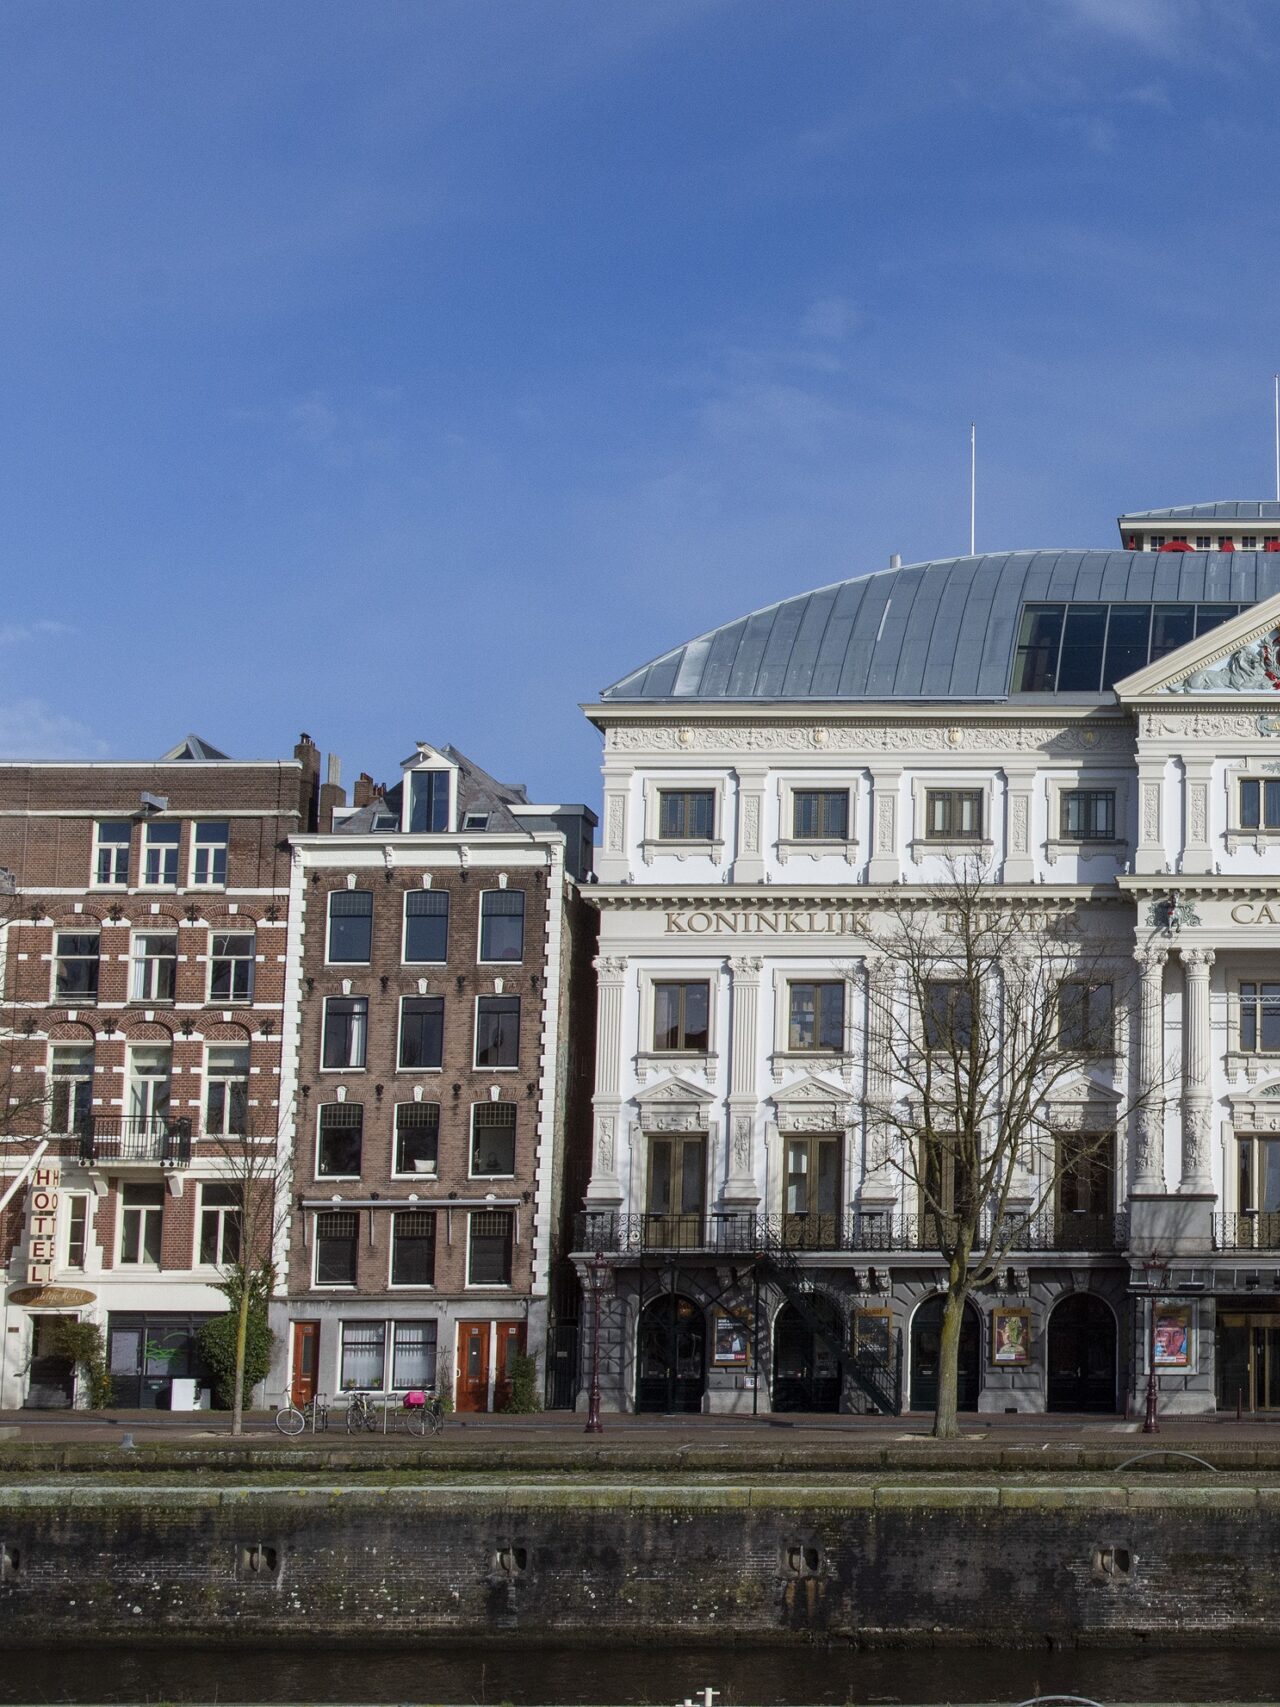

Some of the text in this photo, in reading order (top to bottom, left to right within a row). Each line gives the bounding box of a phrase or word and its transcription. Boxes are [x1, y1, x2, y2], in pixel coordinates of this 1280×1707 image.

[664, 912, 1085, 935] KONINKLIJK THEATER
[31, 1169, 50, 1283] HOTEL
